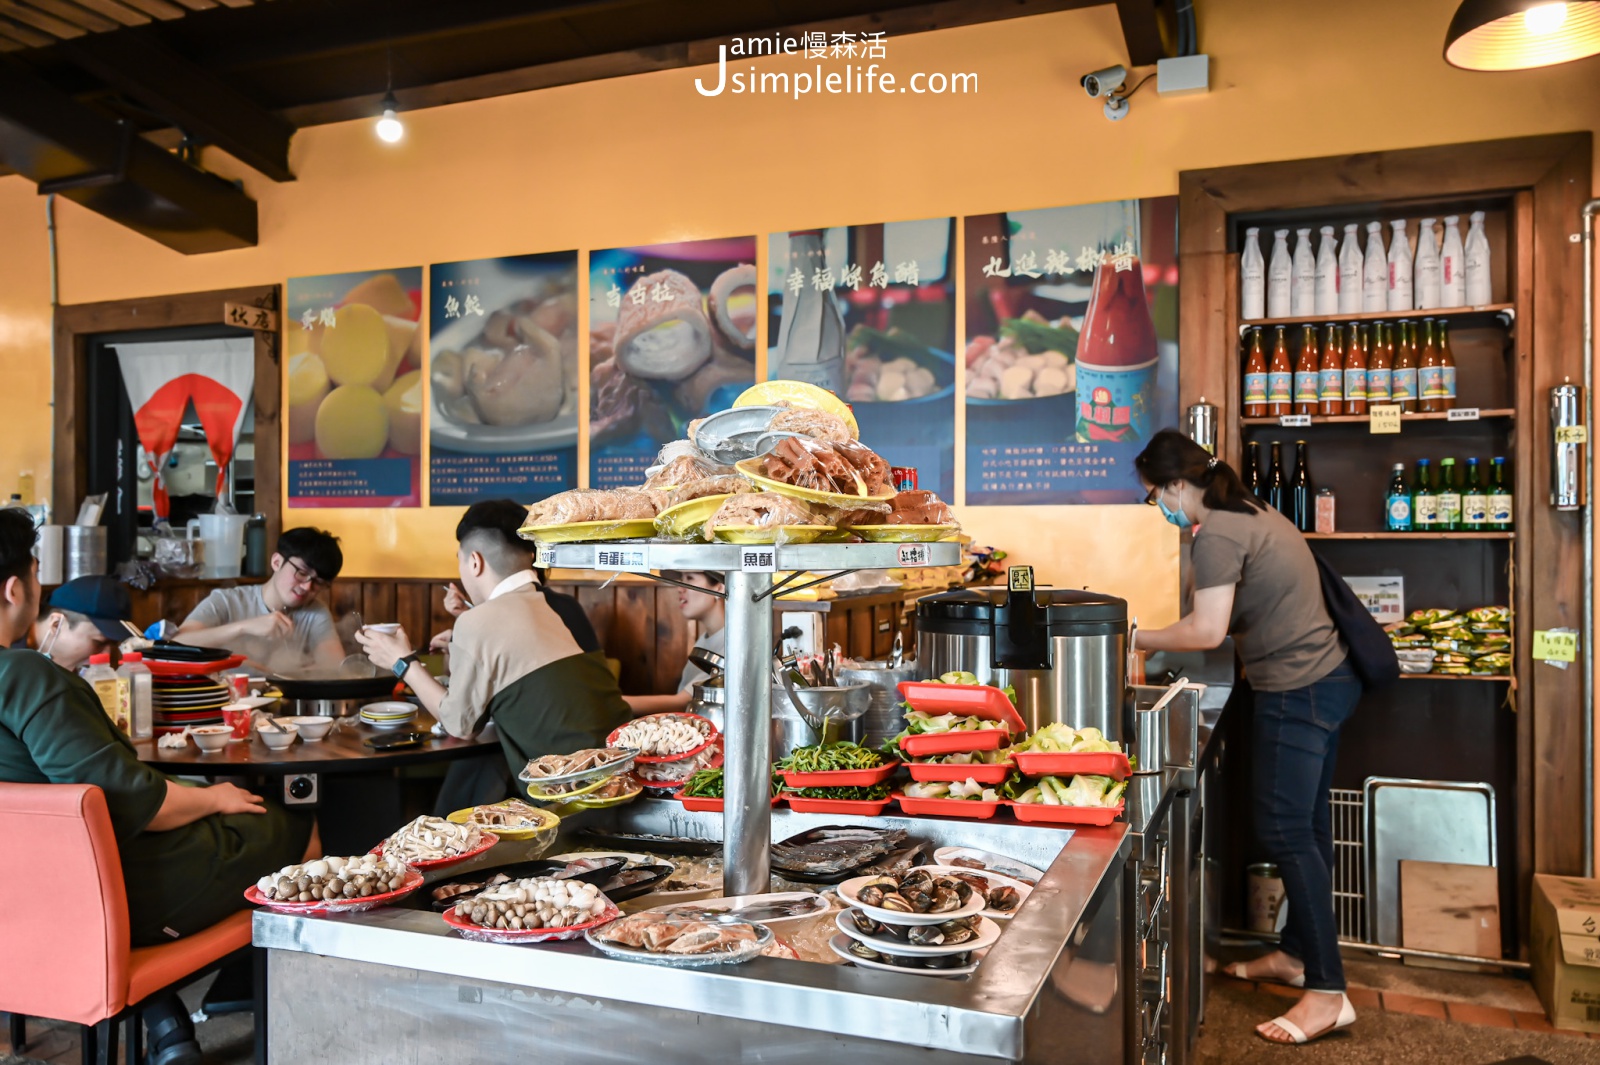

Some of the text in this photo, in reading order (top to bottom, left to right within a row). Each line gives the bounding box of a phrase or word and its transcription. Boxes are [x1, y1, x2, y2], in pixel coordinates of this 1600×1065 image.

[787, 260, 920, 297] 幸福牌烏醋
[606, 283, 675, 308] 吉古拉
[744, 552, 773, 566] 魚酥
